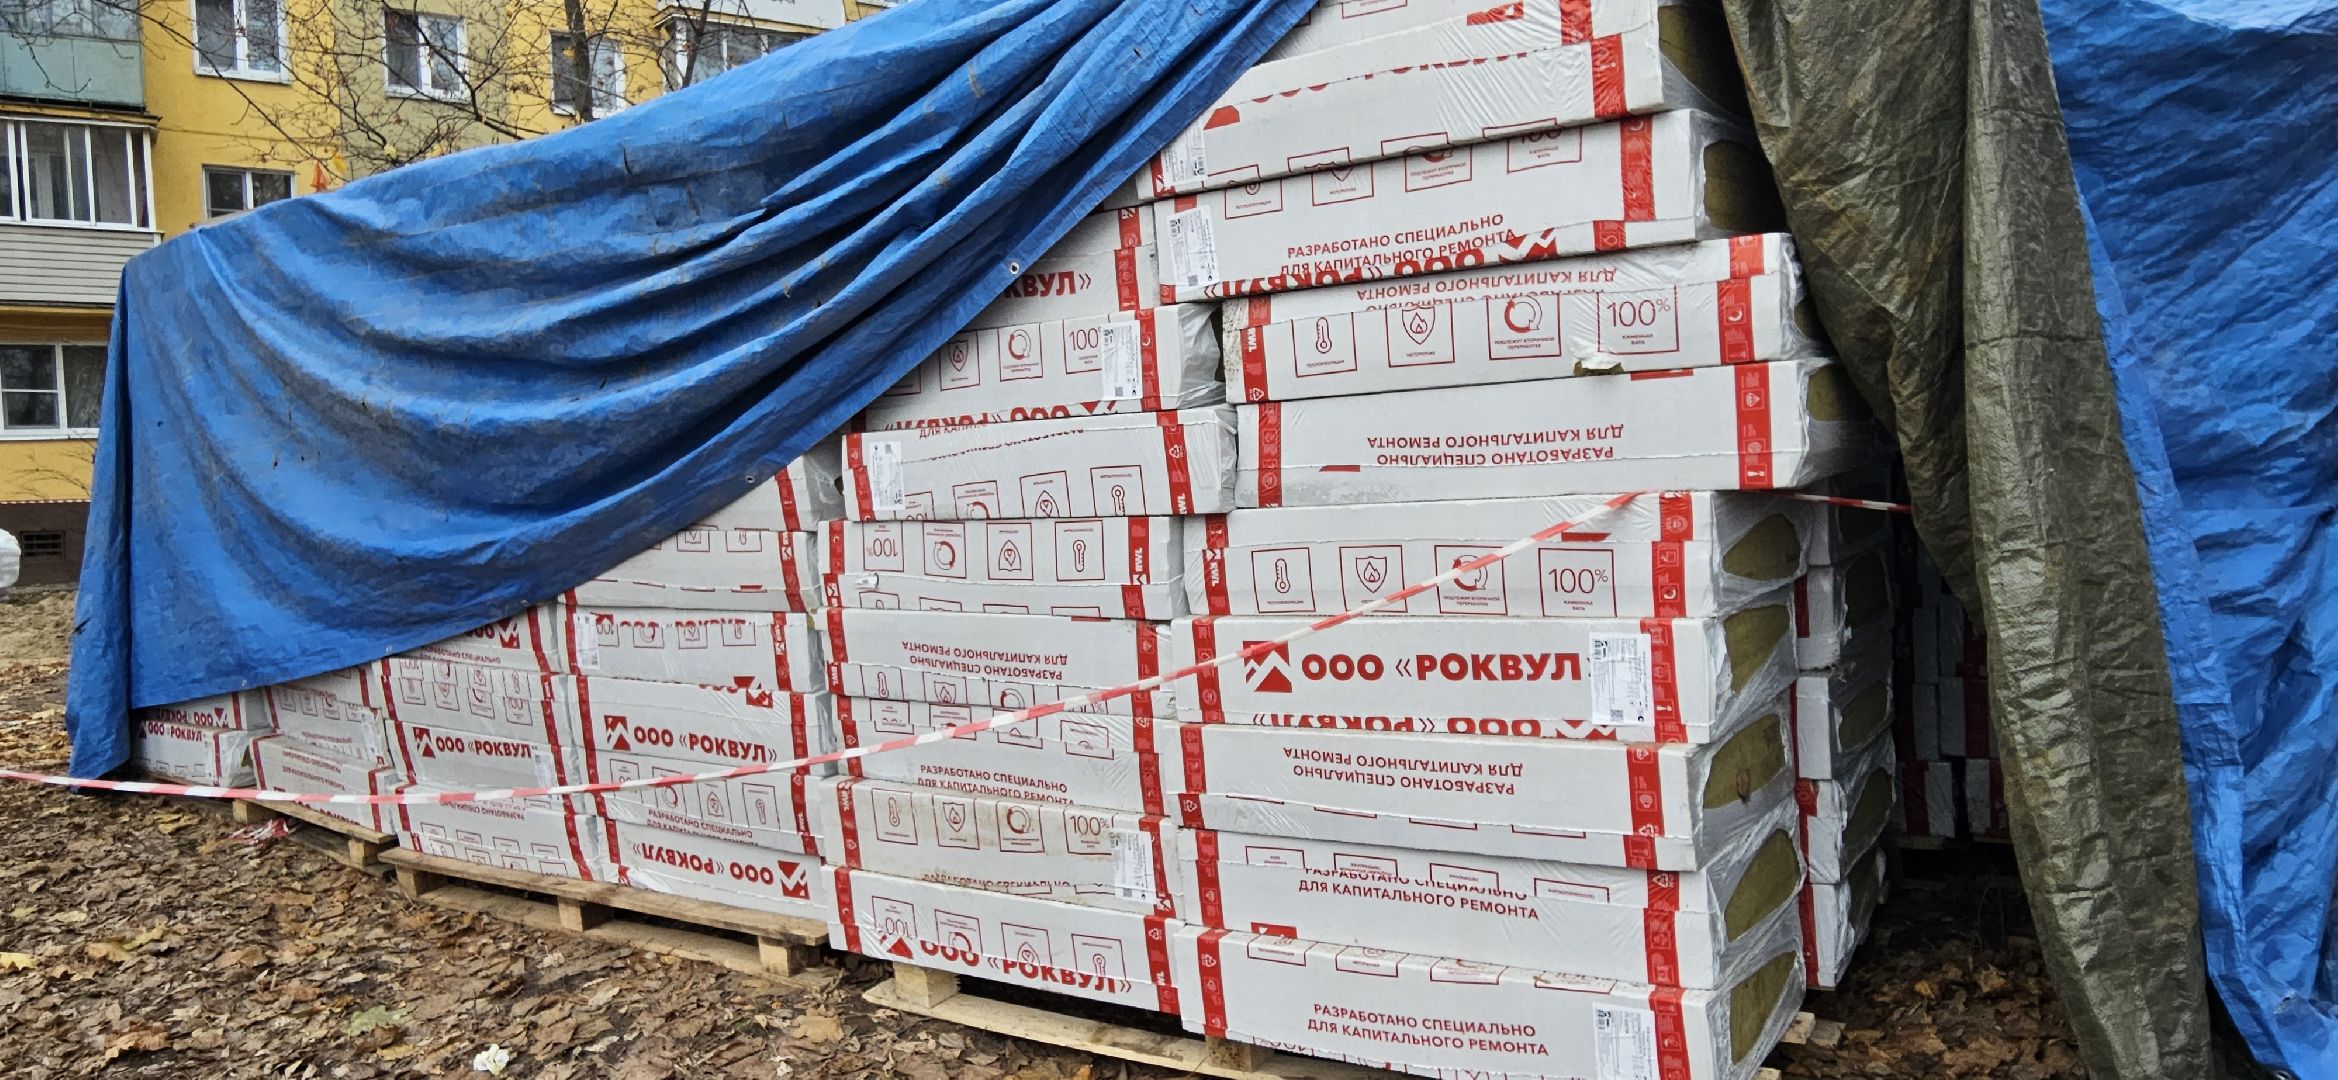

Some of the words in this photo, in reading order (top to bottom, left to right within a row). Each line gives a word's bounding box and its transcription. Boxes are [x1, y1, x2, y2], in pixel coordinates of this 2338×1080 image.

[1287, 234, 1391, 259] РАЗРАБОТАНО
[1394, 213, 1504, 245] СПЕЦИАЛЬНО
[1314, 246, 1434, 275] КАПИТАЛЬНОГО
[1438, 228, 1516, 260] РЕМОНТА
[1435, 270, 1572, 293] КАПИТАЛЬНОГО
[1578, 267, 1618, 284] ДЛЯ
[1356, 281, 1430, 300] РЕМОНТА
[1606, 298, 1671, 328] 100%
[1445, 428, 1580, 447] КАПИТАЛЬНОГО
[1586, 423, 1624, 439] ДЛЯ
[1367, 435, 1440, 449] РЕМОНТА
[1376, 453, 1486, 466] СПЕЦИАЛЬНО
[1491, 446, 1614, 464] РАЗРАБОТАНО
[1548, 568, 1609, 594] 100%
[901, 640, 951, 656] РЕМОНТА
[953, 647, 1041, 664] КАПИТАЛЬНОГО
[909, 655, 980, 674] СПЕЦИАЛЬНО
[1044, 652, 1068, 666] ДЛЯ
[1301, 653, 1385, 681] ООО
[1394, 652, 1591, 682] «РОКВУЛ
[983, 666, 1063, 681] РАЗРАБОТАНО
[435, 735, 466, 754] ООО
[633, 725, 675, 747] ООО
[678, 732, 778, 763] «РОКВУЛ»
[1283, 747, 1351, 765] РЕМОНТА
[1356, 754, 1483, 774] КАПИТАЛЬНОГО
[920, 764, 991, 780] РАЗРАБОТАНО
[993, 772, 1068, 793] СПЕЦИАЛЬНО
[1293, 764, 1395, 786] СПЕЦИАЛЬНО
[1488, 762, 1523, 777] ДЛЯ
[940, 779, 1021, 799] КАПИТАЛЬНОГО
[1400, 776, 1515, 795] РАЗРАБОТАНО
[701, 821, 753, 838] СПЕЦИАЛЬНО
[1069, 815, 1110, 836] 100%
[632, 842, 725, 875] «РОКВУЛ»
[729, 861, 774, 885] ООО
[1299, 879, 1328, 892] ДЛЯ
[1333, 882, 1455, 907] КАПИТАЛЬНОГО
[1460, 896, 1539, 921] РЕМОНТА
[1314, 1003, 1417, 1027] РАЗРАБОТАНО
[1422, 1017, 1536, 1037] СПЕЦИАЛЬНО
[1307, 1019, 1337, 1033] ДЛЯ
[1343, 1025, 1464, 1049] КАПИТАЛЬНОГО
[1469, 1038, 1549, 1056] РЕМОНТА
